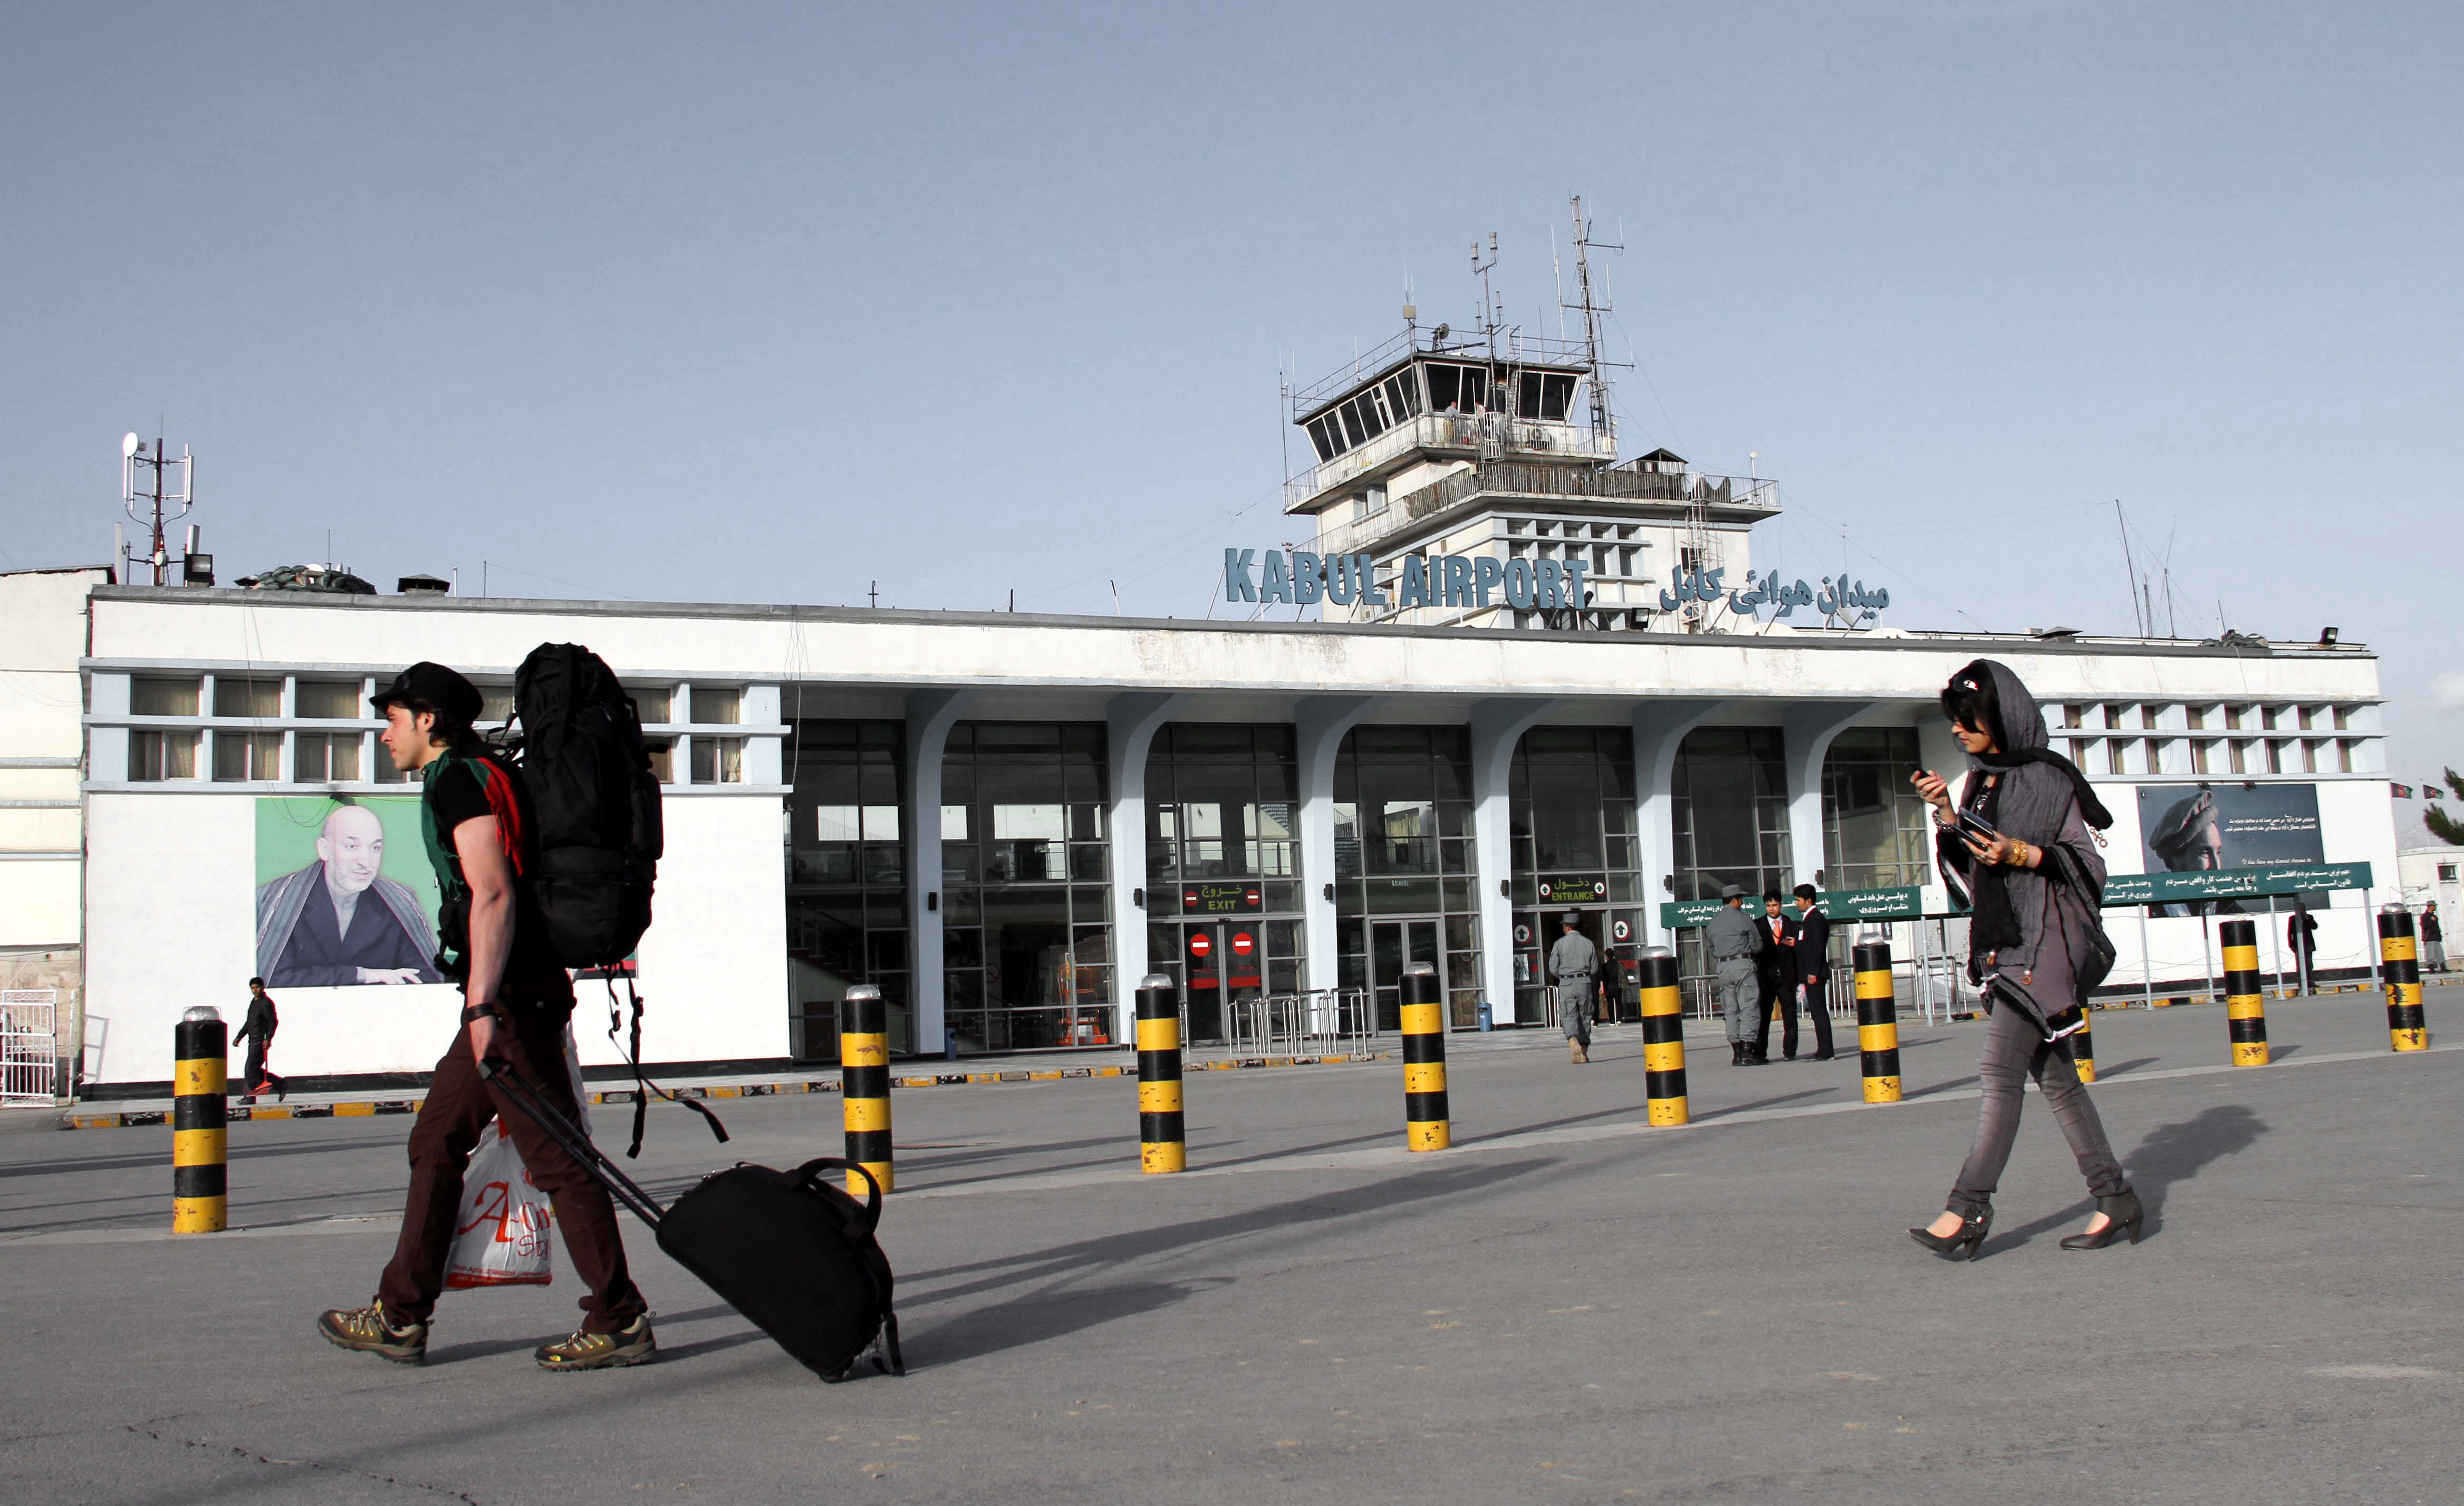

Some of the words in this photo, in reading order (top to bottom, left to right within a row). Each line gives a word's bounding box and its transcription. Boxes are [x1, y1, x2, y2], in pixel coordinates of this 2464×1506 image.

[1225, 548, 1386, 606] KABUL
[1399, 555, 1589, 610] AIRPORT
[1660, 564, 1724, 616] کابل
[1817, 573, 1889, 620] میدان
[1554, 877, 1590, 890] دخول
[2115, 880, 2135, 889] ملی
[2216, 874, 2234, 882] خدمت
[1202, 884, 1242, 897] خروج
[1552, 891, 1595, 901] ENTRANCE
[1208, 900, 1237, 910] EXIT
